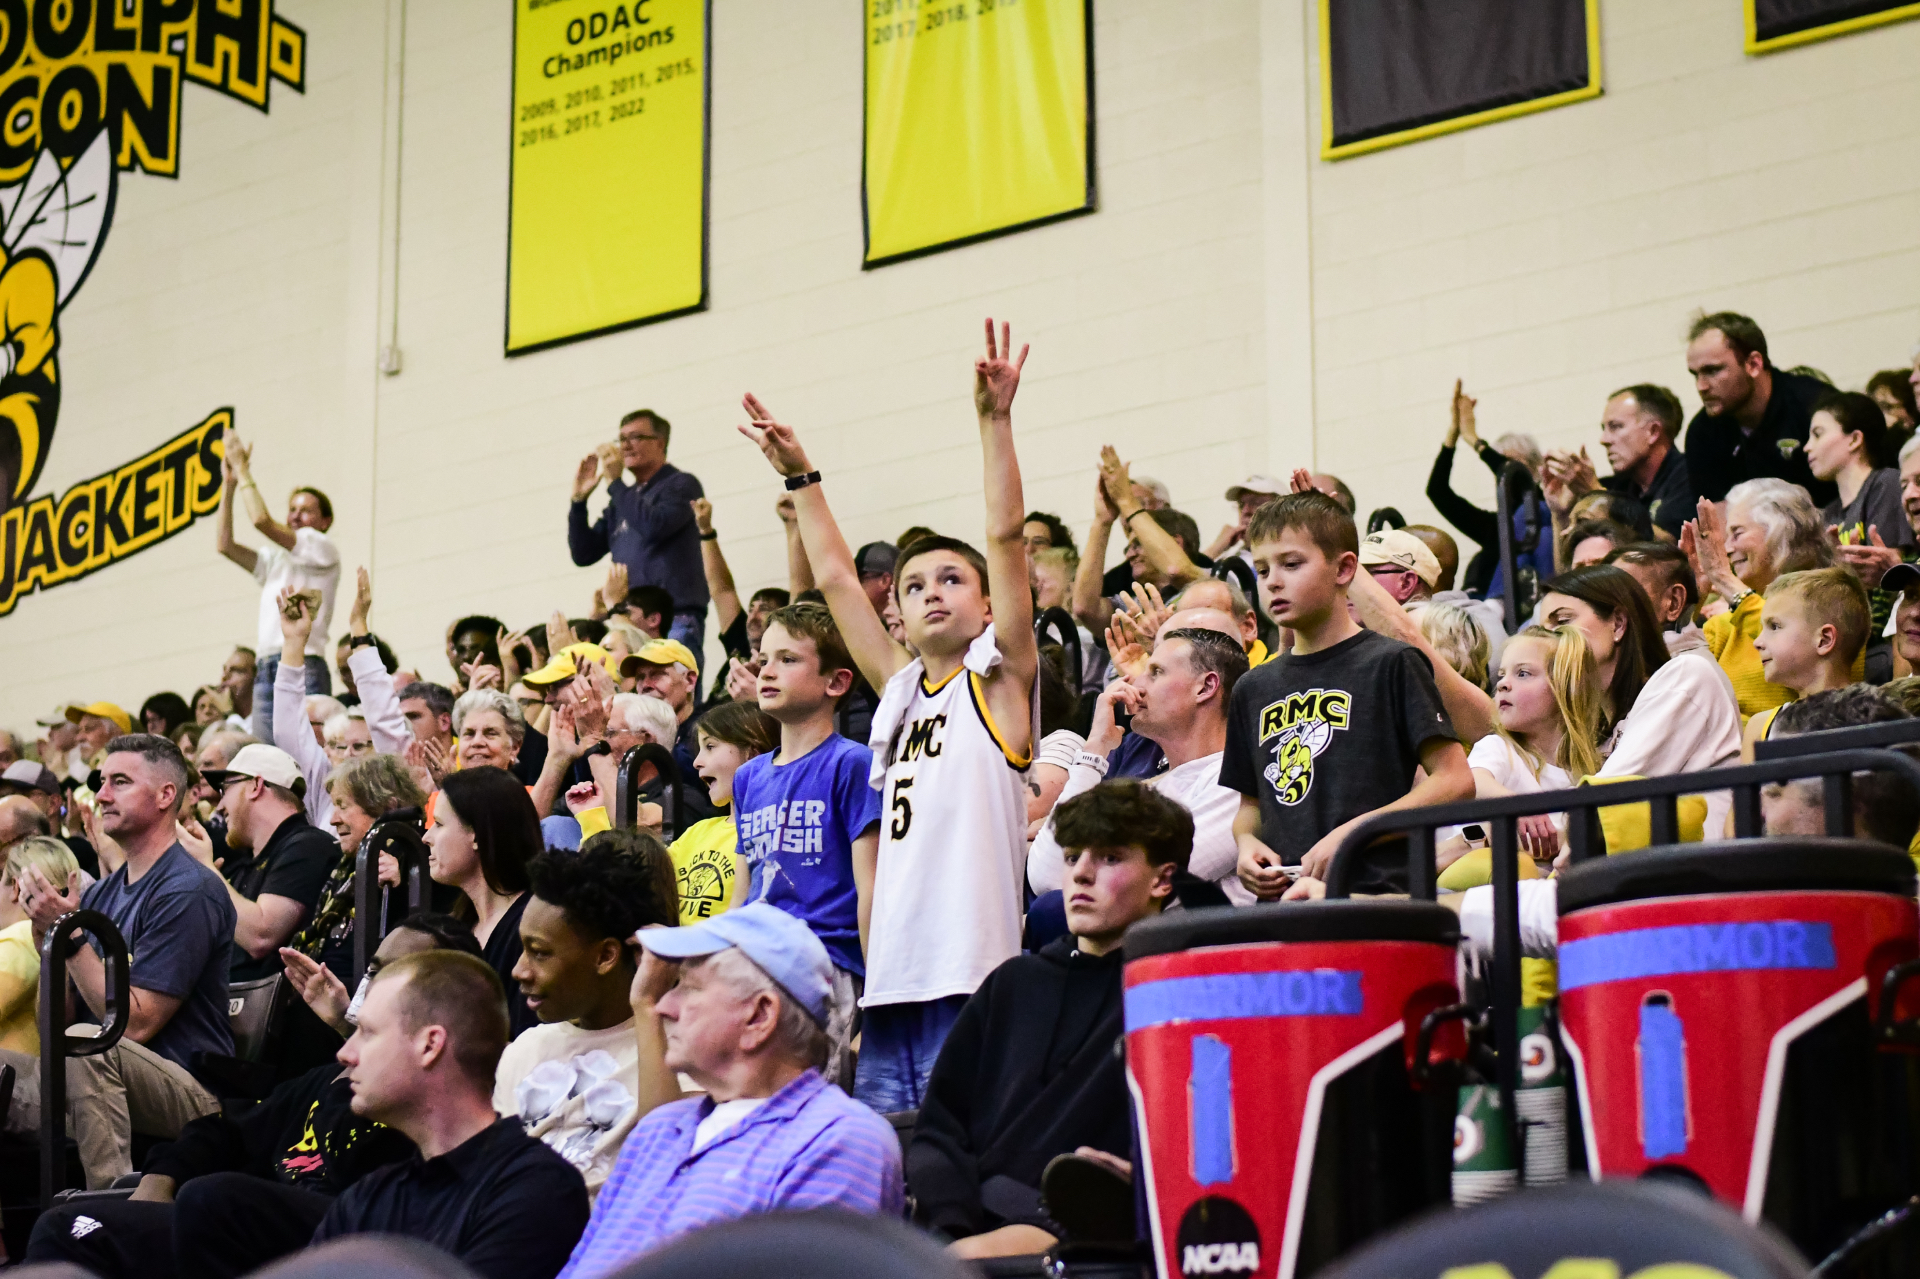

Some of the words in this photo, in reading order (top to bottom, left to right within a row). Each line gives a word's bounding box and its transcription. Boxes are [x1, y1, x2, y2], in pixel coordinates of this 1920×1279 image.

[567, 0, 651, 45] ODAC
[543, 26, 675, 79] Champions
[609, 97, 646, 122] 2022
[0, 409, 229, 613] JACKETS
[886, 714, 947, 764] MC
[1259, 689, 1352, 747] RMC
[891, 776, 914, 841] 5
[707, 849, 721, 862] TO
[718, 854, 735, 879] THE
[679, 898, 712, 918] IVE
[1182, 1242, 1259, 1275] NCAA
